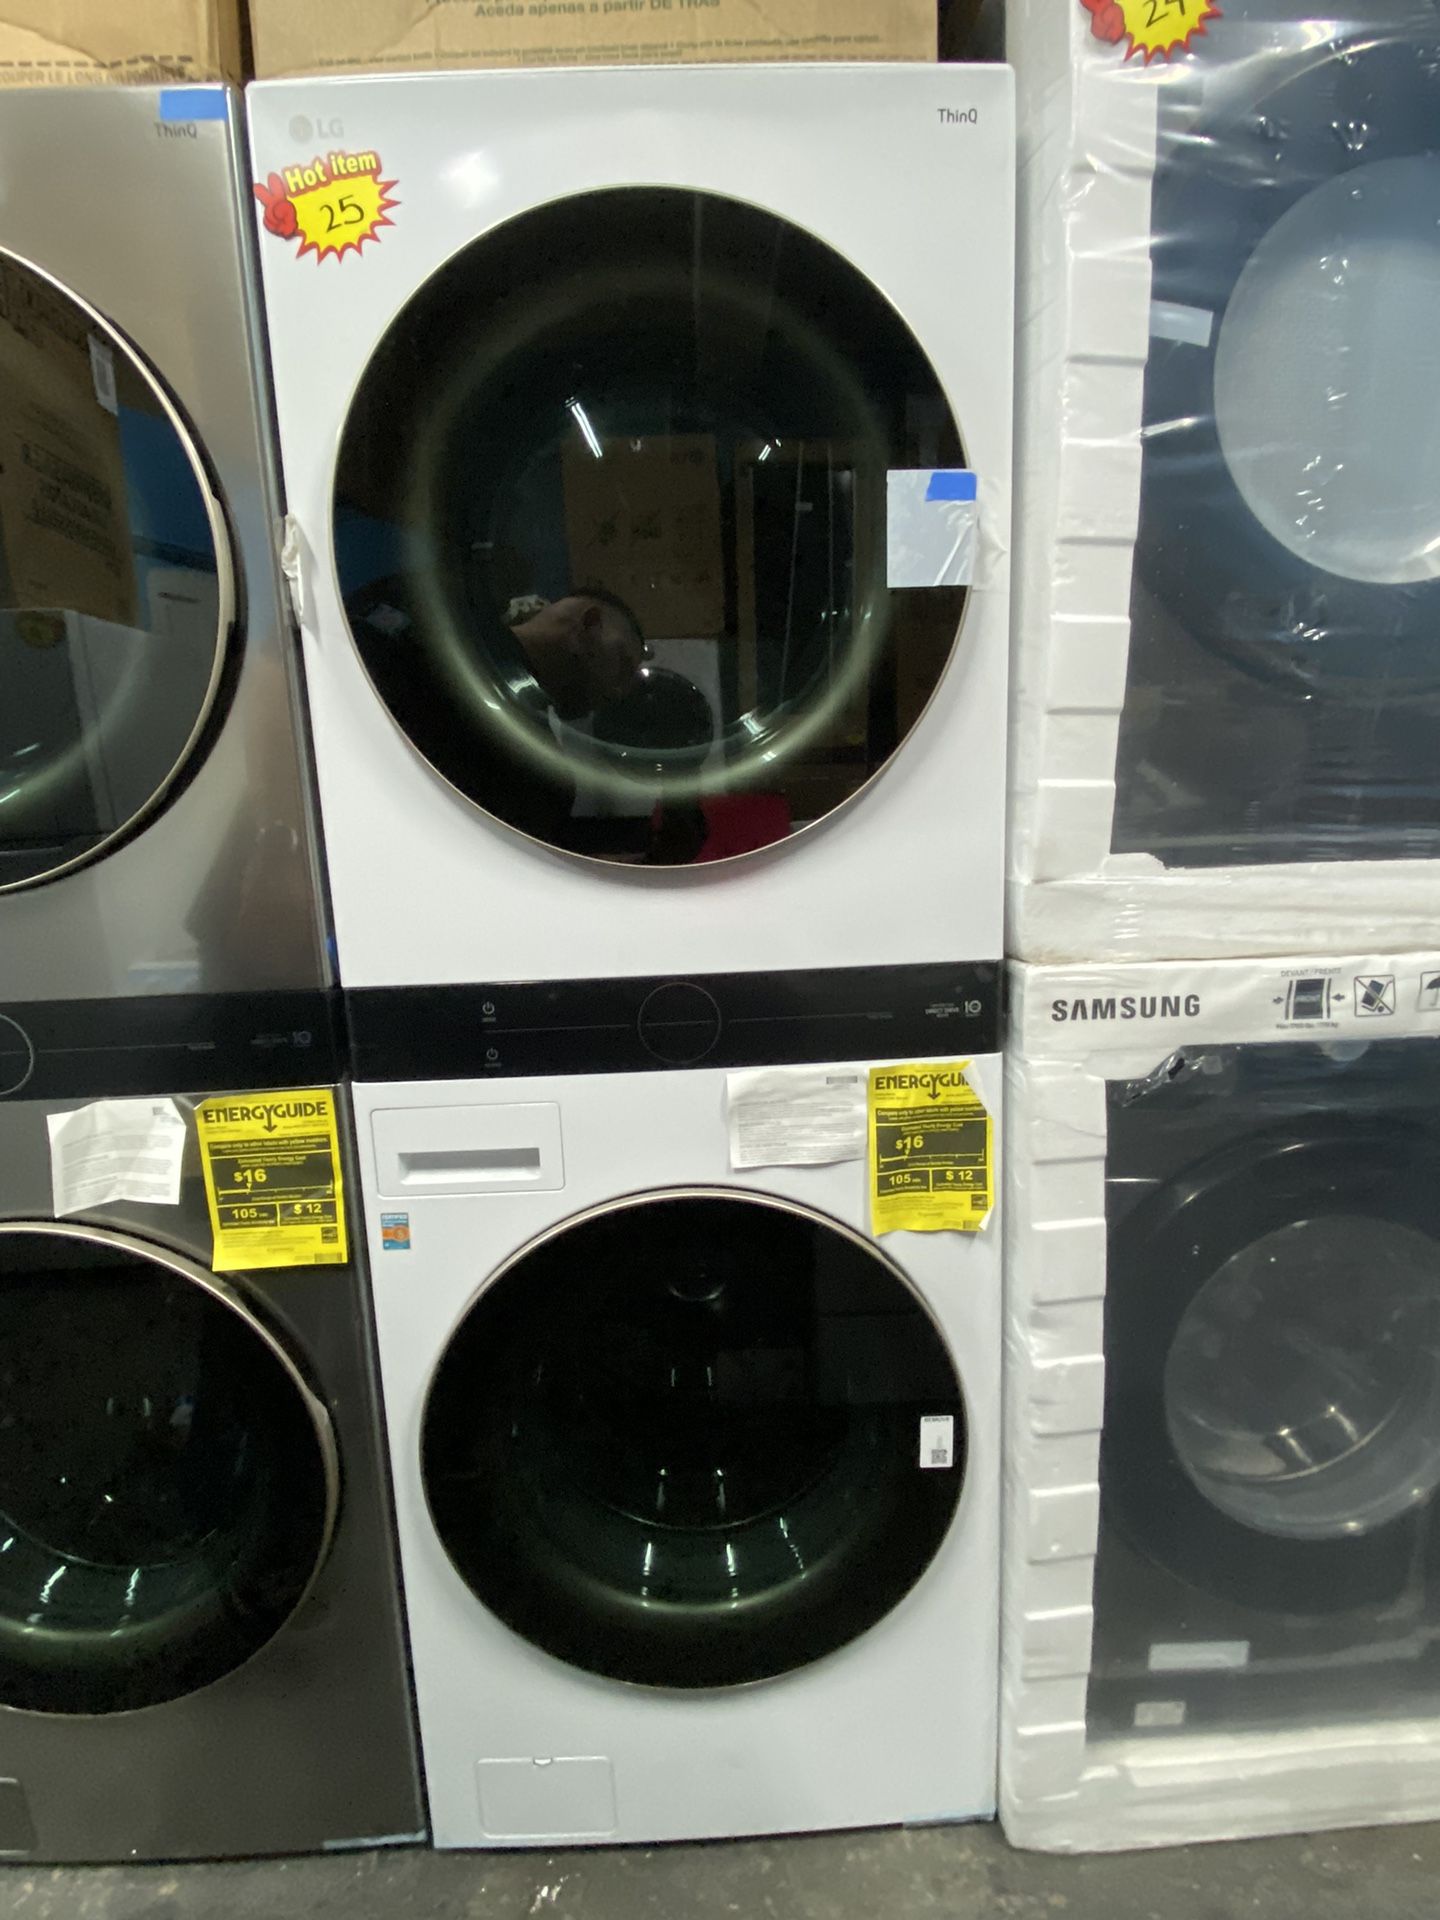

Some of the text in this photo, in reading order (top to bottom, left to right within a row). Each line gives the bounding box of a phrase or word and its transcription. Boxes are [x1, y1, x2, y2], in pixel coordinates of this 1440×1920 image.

[475, 4, 524, 16] Aceda
[528, 2, 584, 16] apenas
[603, 0, 645, 13] partir
[937, 108, 978, 125] ThinQ
[154, 123, 197, 138] ThinQ
[317, 118, 345, 139] LG
[284, 153, 377, 193] Hot item
[319, 195, 365, 233] 25
[1051, 994, 1200, 1022] SAMSUNG
[203, 1101, 328, 1126] ENERGYGUIDE
[895, 1135, 924, 1150] $16
[233, 1168, 267, 1183] $16
[889, 1173, 911, 1186] 105
[958, 1170, 973, 1180] 12
[232, 1208, 258, 1220] 105
[306, 1202, 322, 1214] 12
